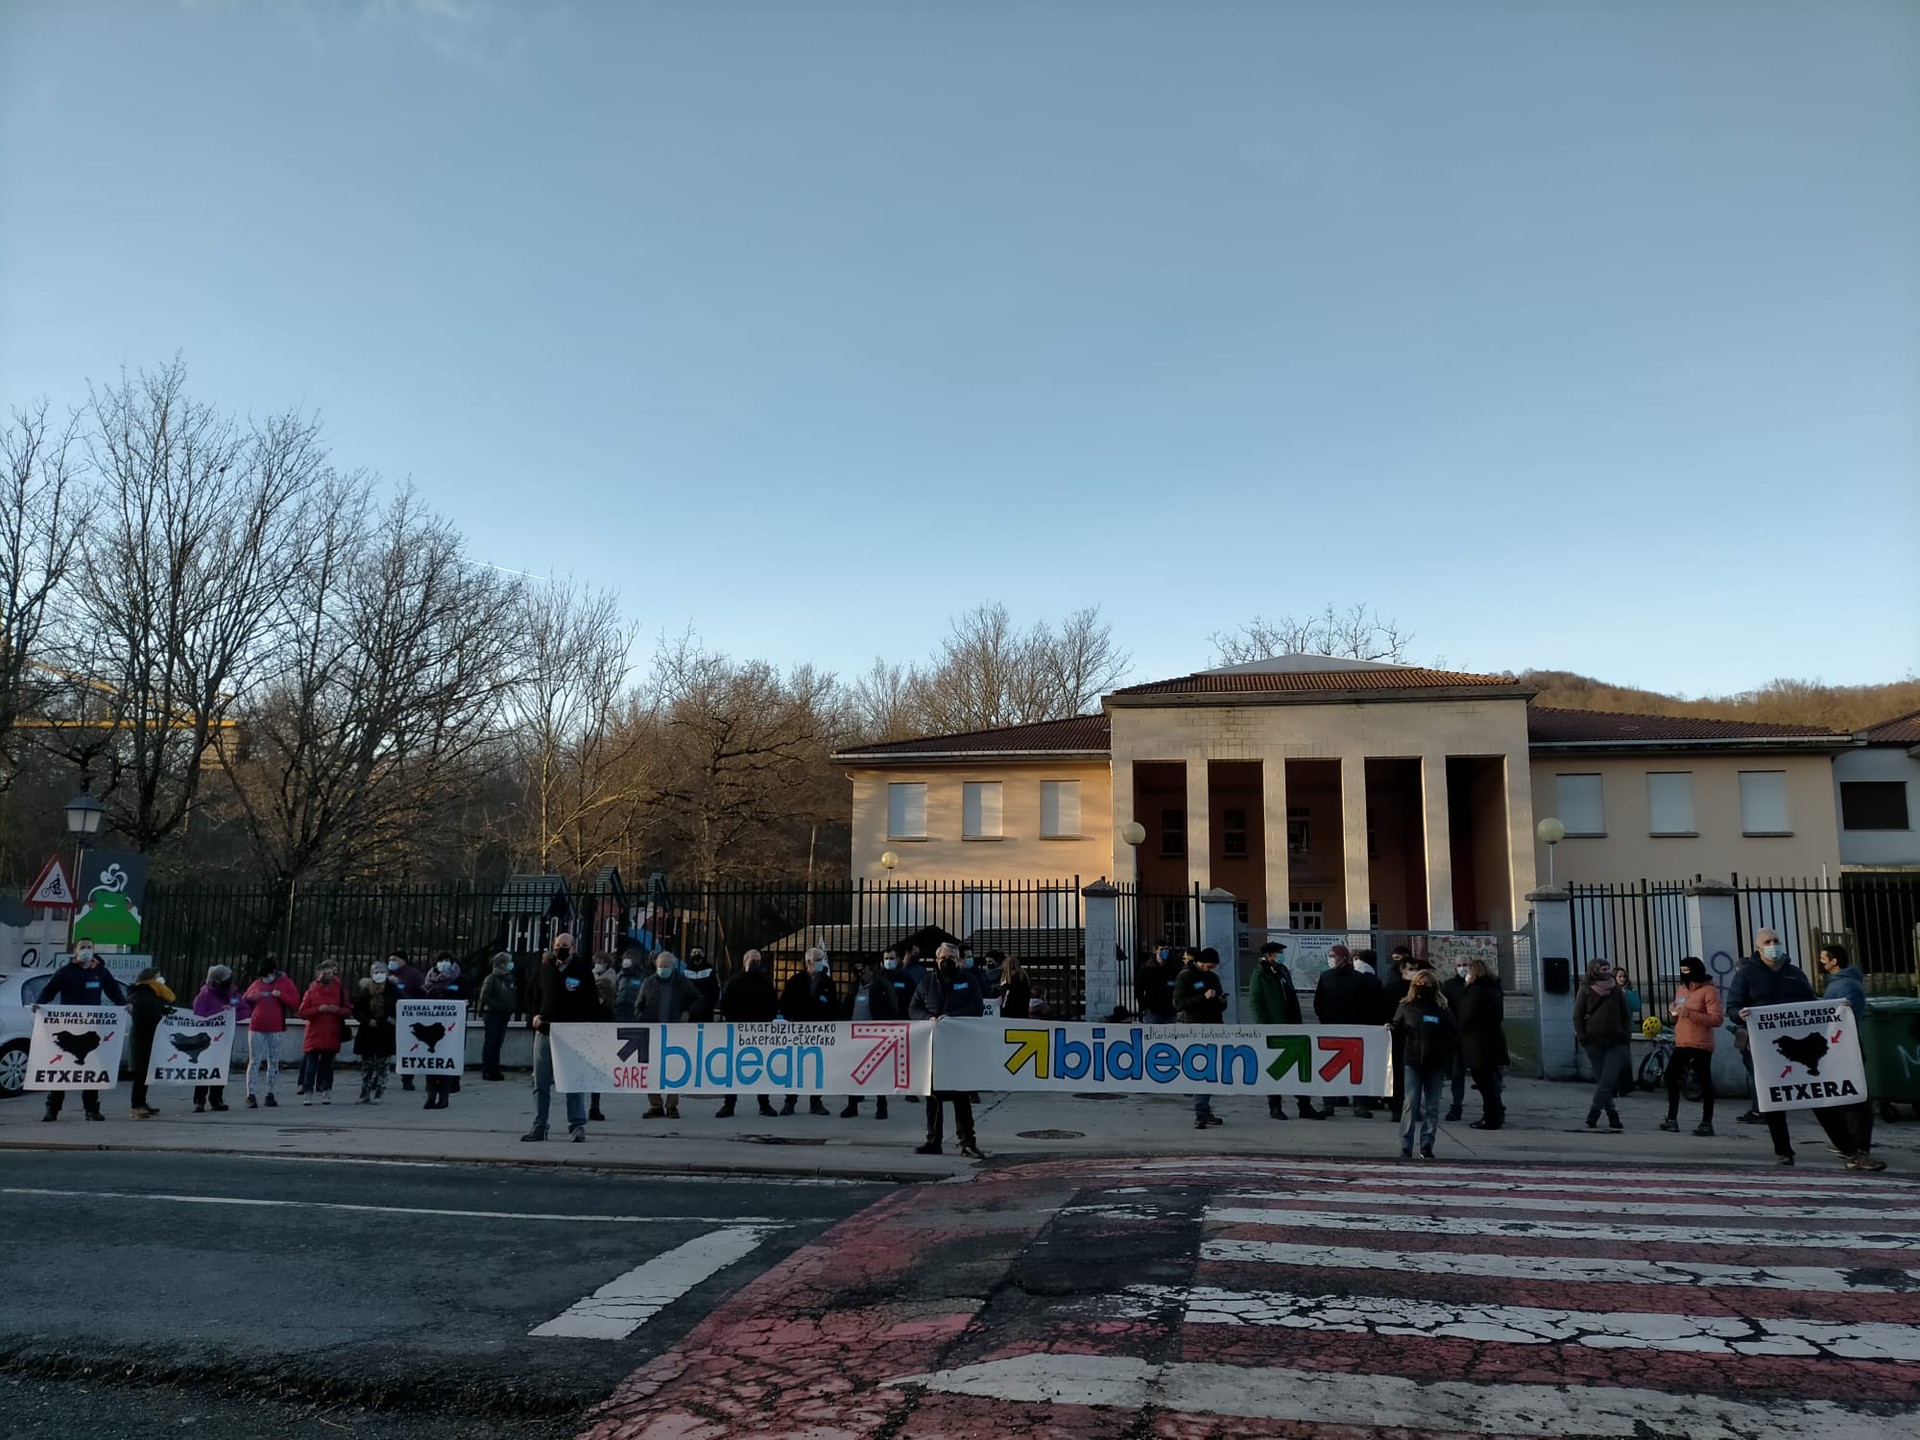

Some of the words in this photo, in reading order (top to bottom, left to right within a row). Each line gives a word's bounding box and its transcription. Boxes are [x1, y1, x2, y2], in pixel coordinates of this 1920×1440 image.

[1757, 1021, 1776, 1030] ETA
[1779, 1014, 1842, 1028] IHESLARIAK
[1759, 1011, 1800, 1022] EUSKAL
[1803, 1007, 1836, 1019] PRESO
[402, 1057, 455, 1069] ETXERA
[660, 1023, 824, 1090] bidean
[1053, 1027, 1259, 1085] bidean
[35, 1070, 110, 1083] ETXERA
[155, 1067, 221, 1080] ETXERA
[613, 1066, 649, 1089] SARE
[1769, 1080, 1859, 1102] ETXERA
